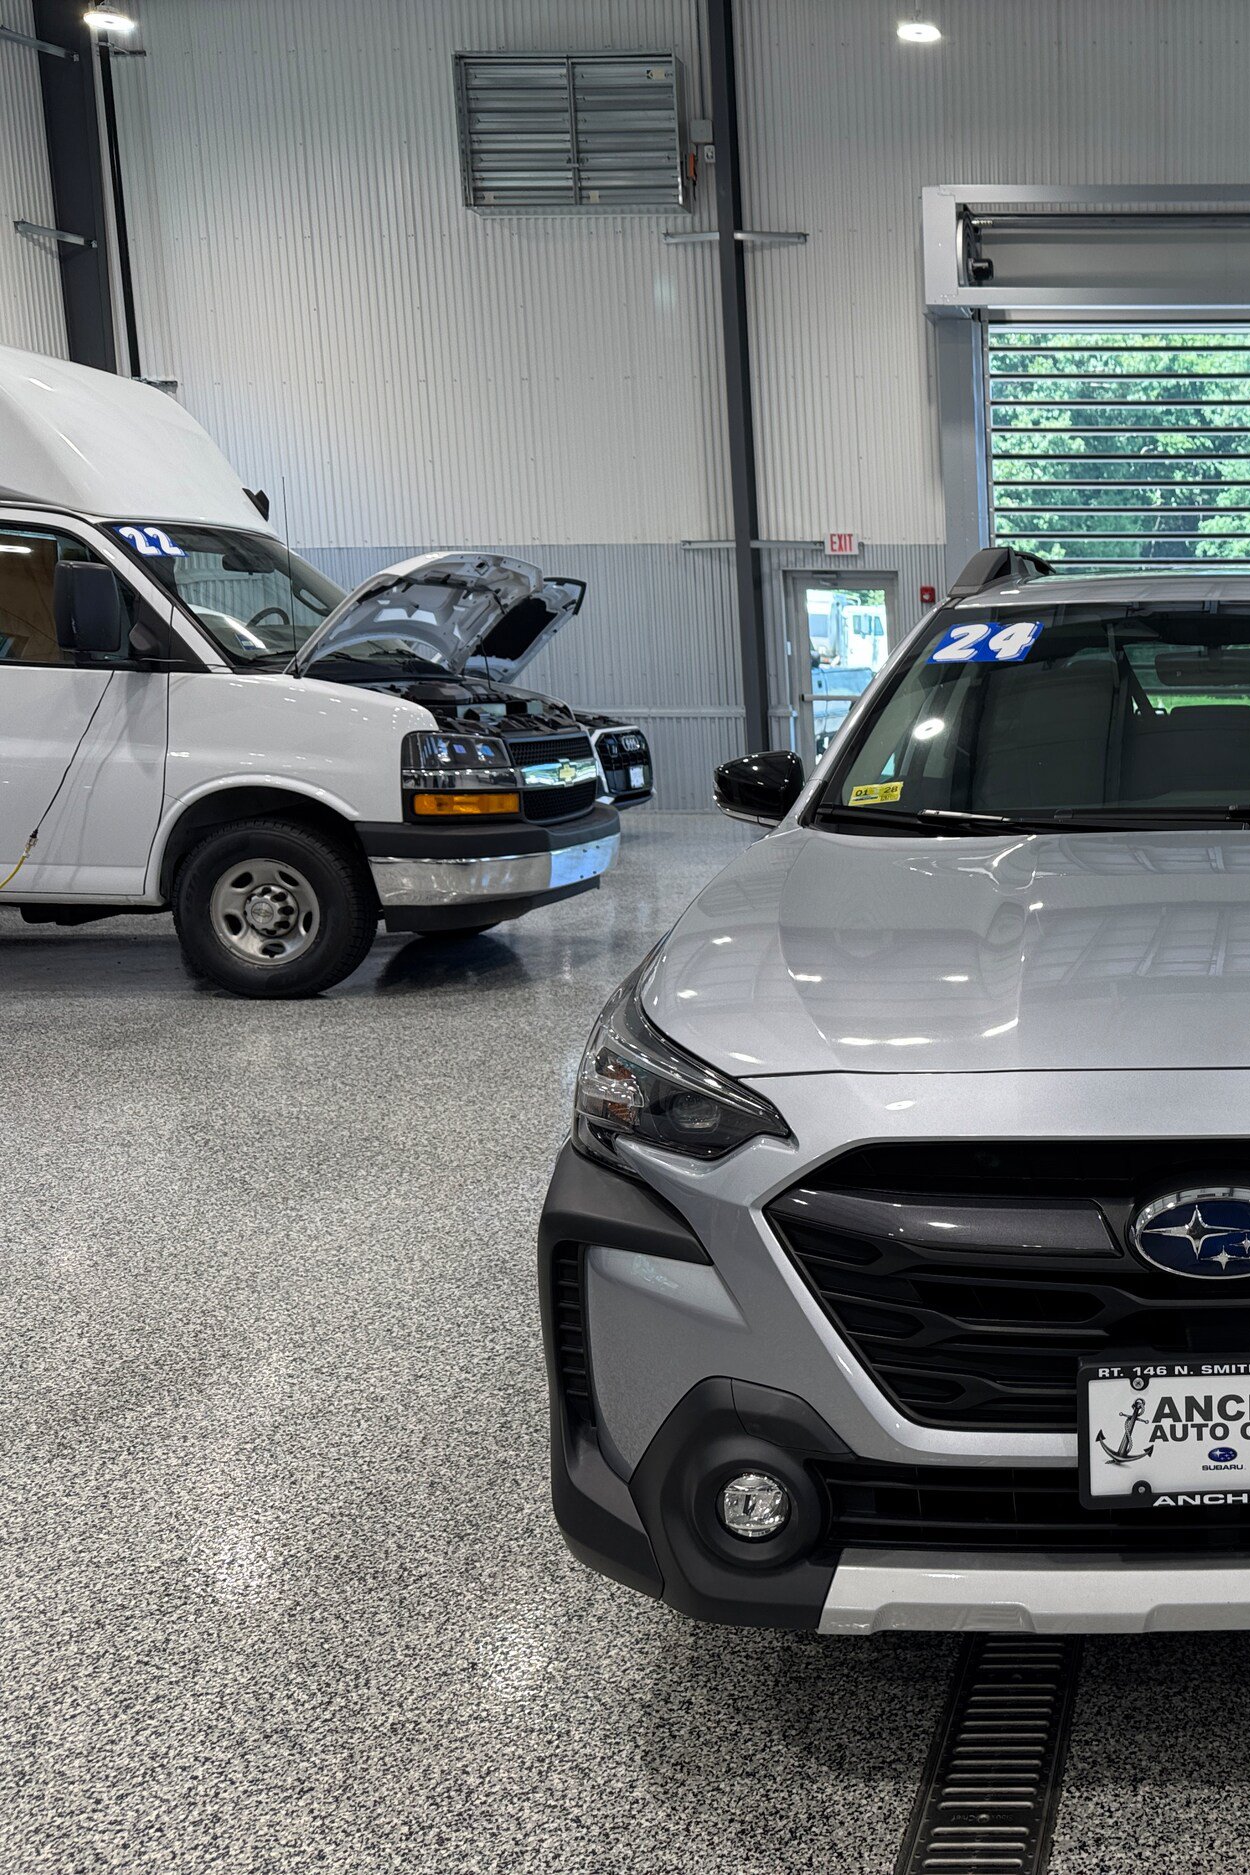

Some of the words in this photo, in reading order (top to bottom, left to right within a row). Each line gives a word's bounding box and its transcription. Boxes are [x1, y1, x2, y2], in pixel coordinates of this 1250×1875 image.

[119, 526, 185, 556] 22
[830, 533, 853, 552] EXIT
[932, 622, 1038, 661] 24
[1098, 1367, 1124, 1378] RT.
[1132, 1366, 1166, 1376] 146
[1174, 1365, 1193, 1375] N.
[1148, 1422, 1230, 1442] AUTO
